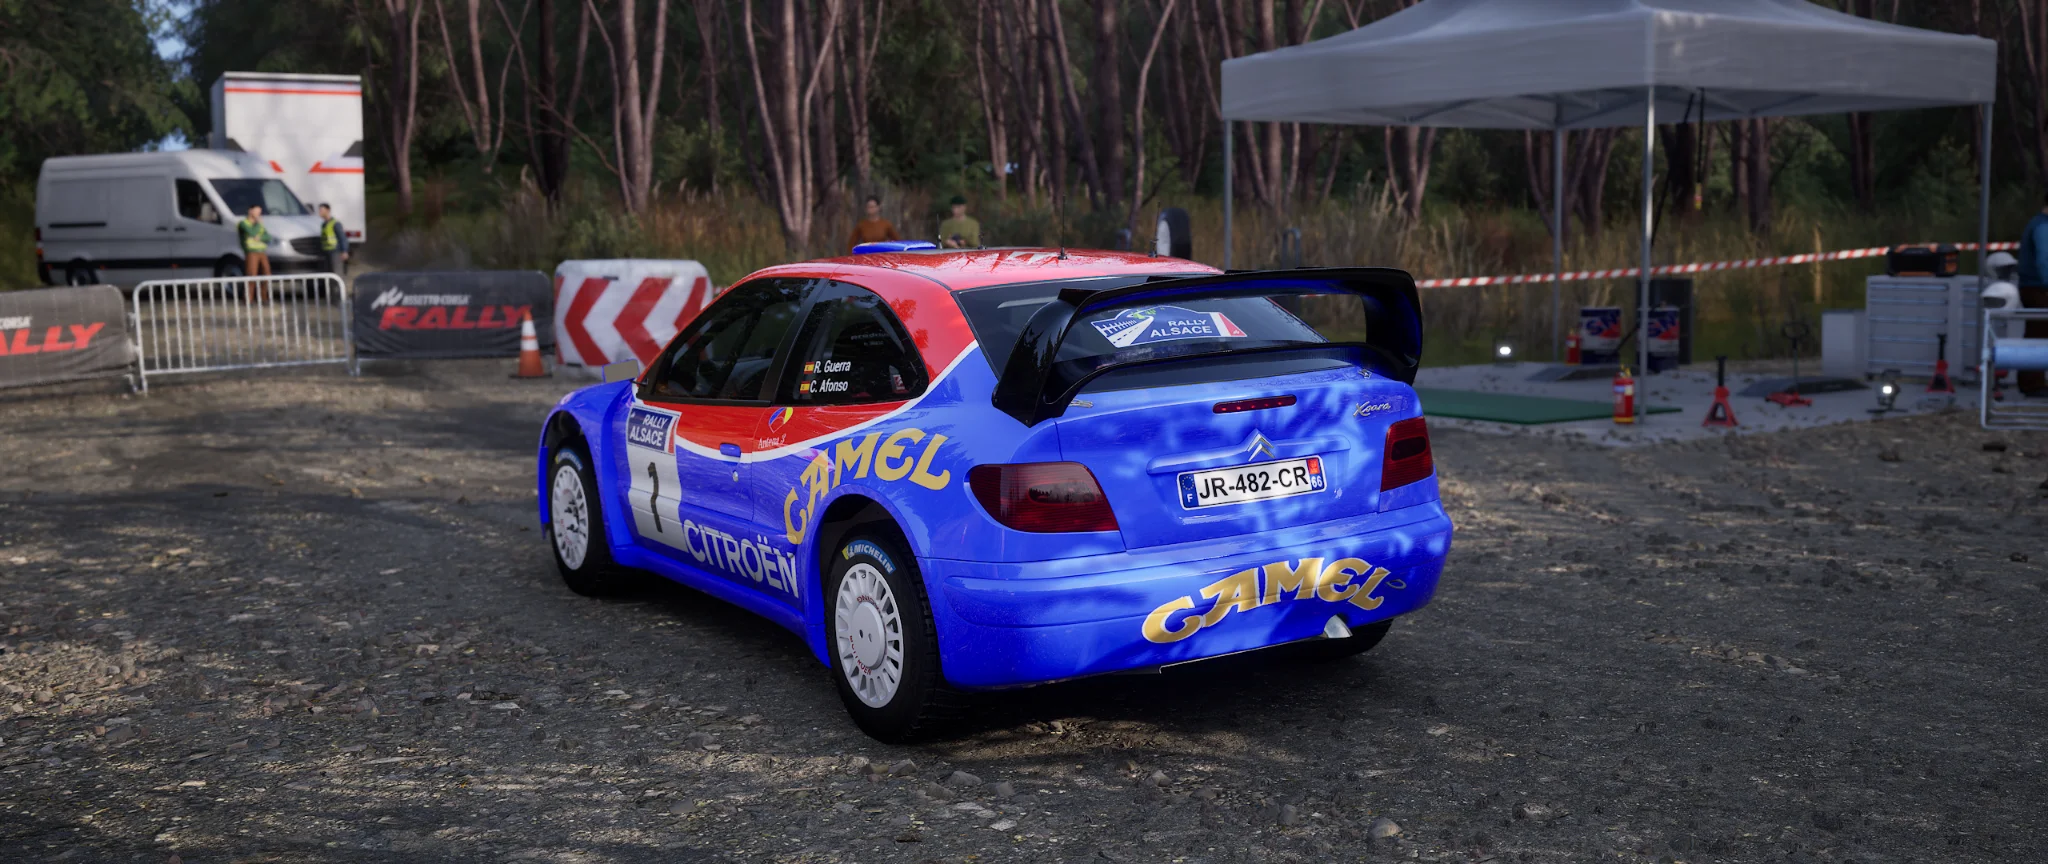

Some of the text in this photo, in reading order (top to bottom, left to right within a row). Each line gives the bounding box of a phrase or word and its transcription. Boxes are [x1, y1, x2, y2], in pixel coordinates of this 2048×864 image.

[378, 305, 532, 330] RALLY
[1167, 319, 1208, 327] RALLY
[1150, 326, 1213, 339] ALSACE
[813, 360, 851, 374] R. Guerra
[810, 378, 848, 393] C. Afonso
[643, 414, 669, 429] RALLY
[630, 425, 664, 447] ALSACE
[783, 428, 951, 545] CAMEL
[1186, 466, 1323, 503] F JR-482-CR 66
[647, 461, 663, 534] 1
[682, 519, 799, 599] CITROËN
[853, 543, 893, 575] MICHELIN
[1142, 557, 1391, 644] CAMEL
